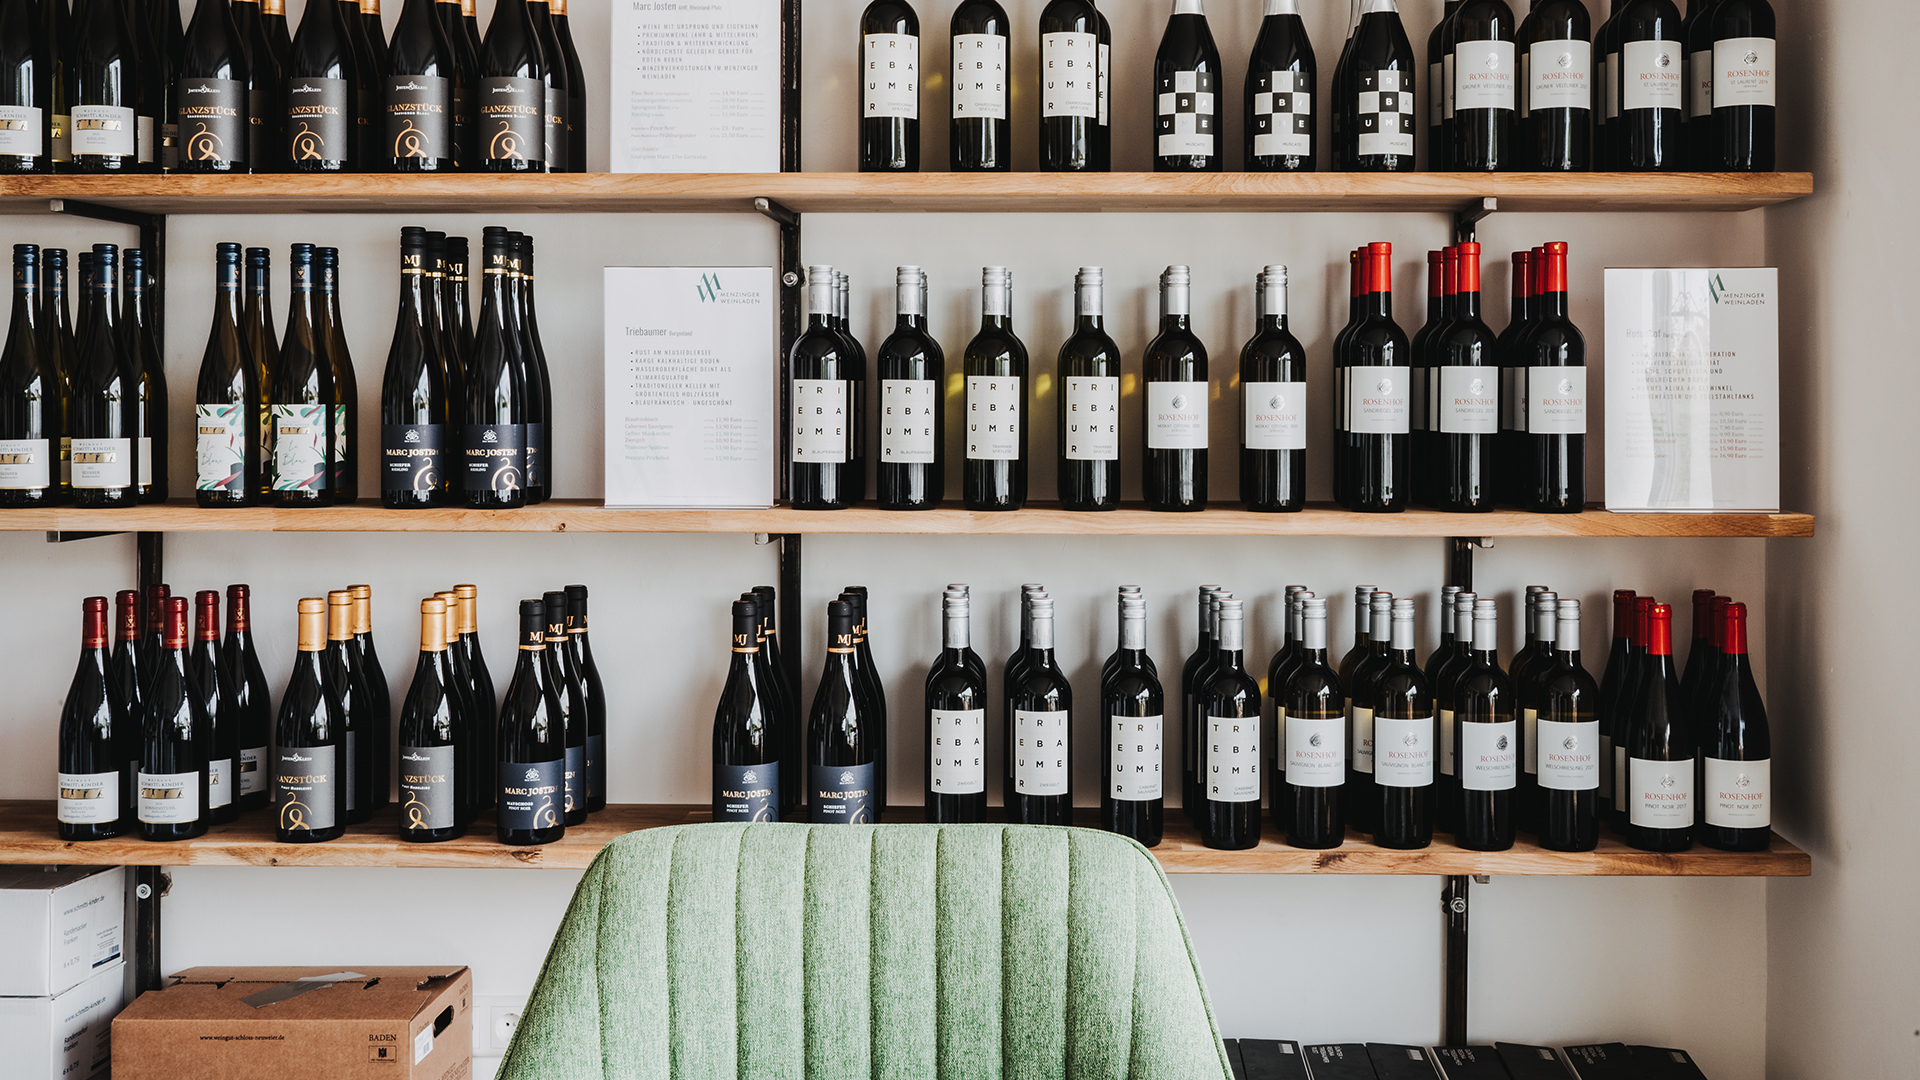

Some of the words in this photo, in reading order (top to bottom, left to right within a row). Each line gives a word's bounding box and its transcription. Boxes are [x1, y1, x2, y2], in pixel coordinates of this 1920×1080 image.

[632, 2, 652, 11] Marc
[653, 2, 677, 11] Josten
[1469, 73, 1510, 82] ROSENHOF
[1542, 72, 1584, 81] ROSENHOF
[1640, 72, 1680, 81] ROSENHOF
[1727, 70, 1770, 78] ROSENHOF
[480, 104, 538, 116] GLANZSTÜCK
[626, 326, 668, 336] Triebaumer
[1362, 398, 1404, 406] ROSENHOF
[1454, 398, 1494, 406] ROSENHOF
[1158, 414, 1199, 422] ROSENHOF
[1256, 414, 1298, 422] ROSENHOF
[386, 448, 407, 456] MARC
[408, 448, 439, 458] JOSTEN
[466, 448, 486, 456] MARC
[486, 448, 518, 458] JOSTEN
[1296, 750, 1338, 758] ROSENHOF
[1548, 754, 1592, 762] ROSENHOF
[504, 786, 526, 794] MARC
[526, 784, 558, 796] JOSTEN
[722, 790, 746, 798] MARC
[820, 790, 843, 799] MARC
[1644, 792, 1688, 800] ROSENHOF
[1719, 792, 1763, 800] ROSENHOF
[63, 895, 105, 916] www.schmitts-kinder.de
[64, 934, 78, 947] Franken
[64, 996, 106, 1024] www.schmitts-kinder.de
[200, 1034, 285, 1042] www.weingut-schloss-neuweier.de
[368, 1034, 397, 1042] BADEN
[64, 1040, 78, 1054] Franken
